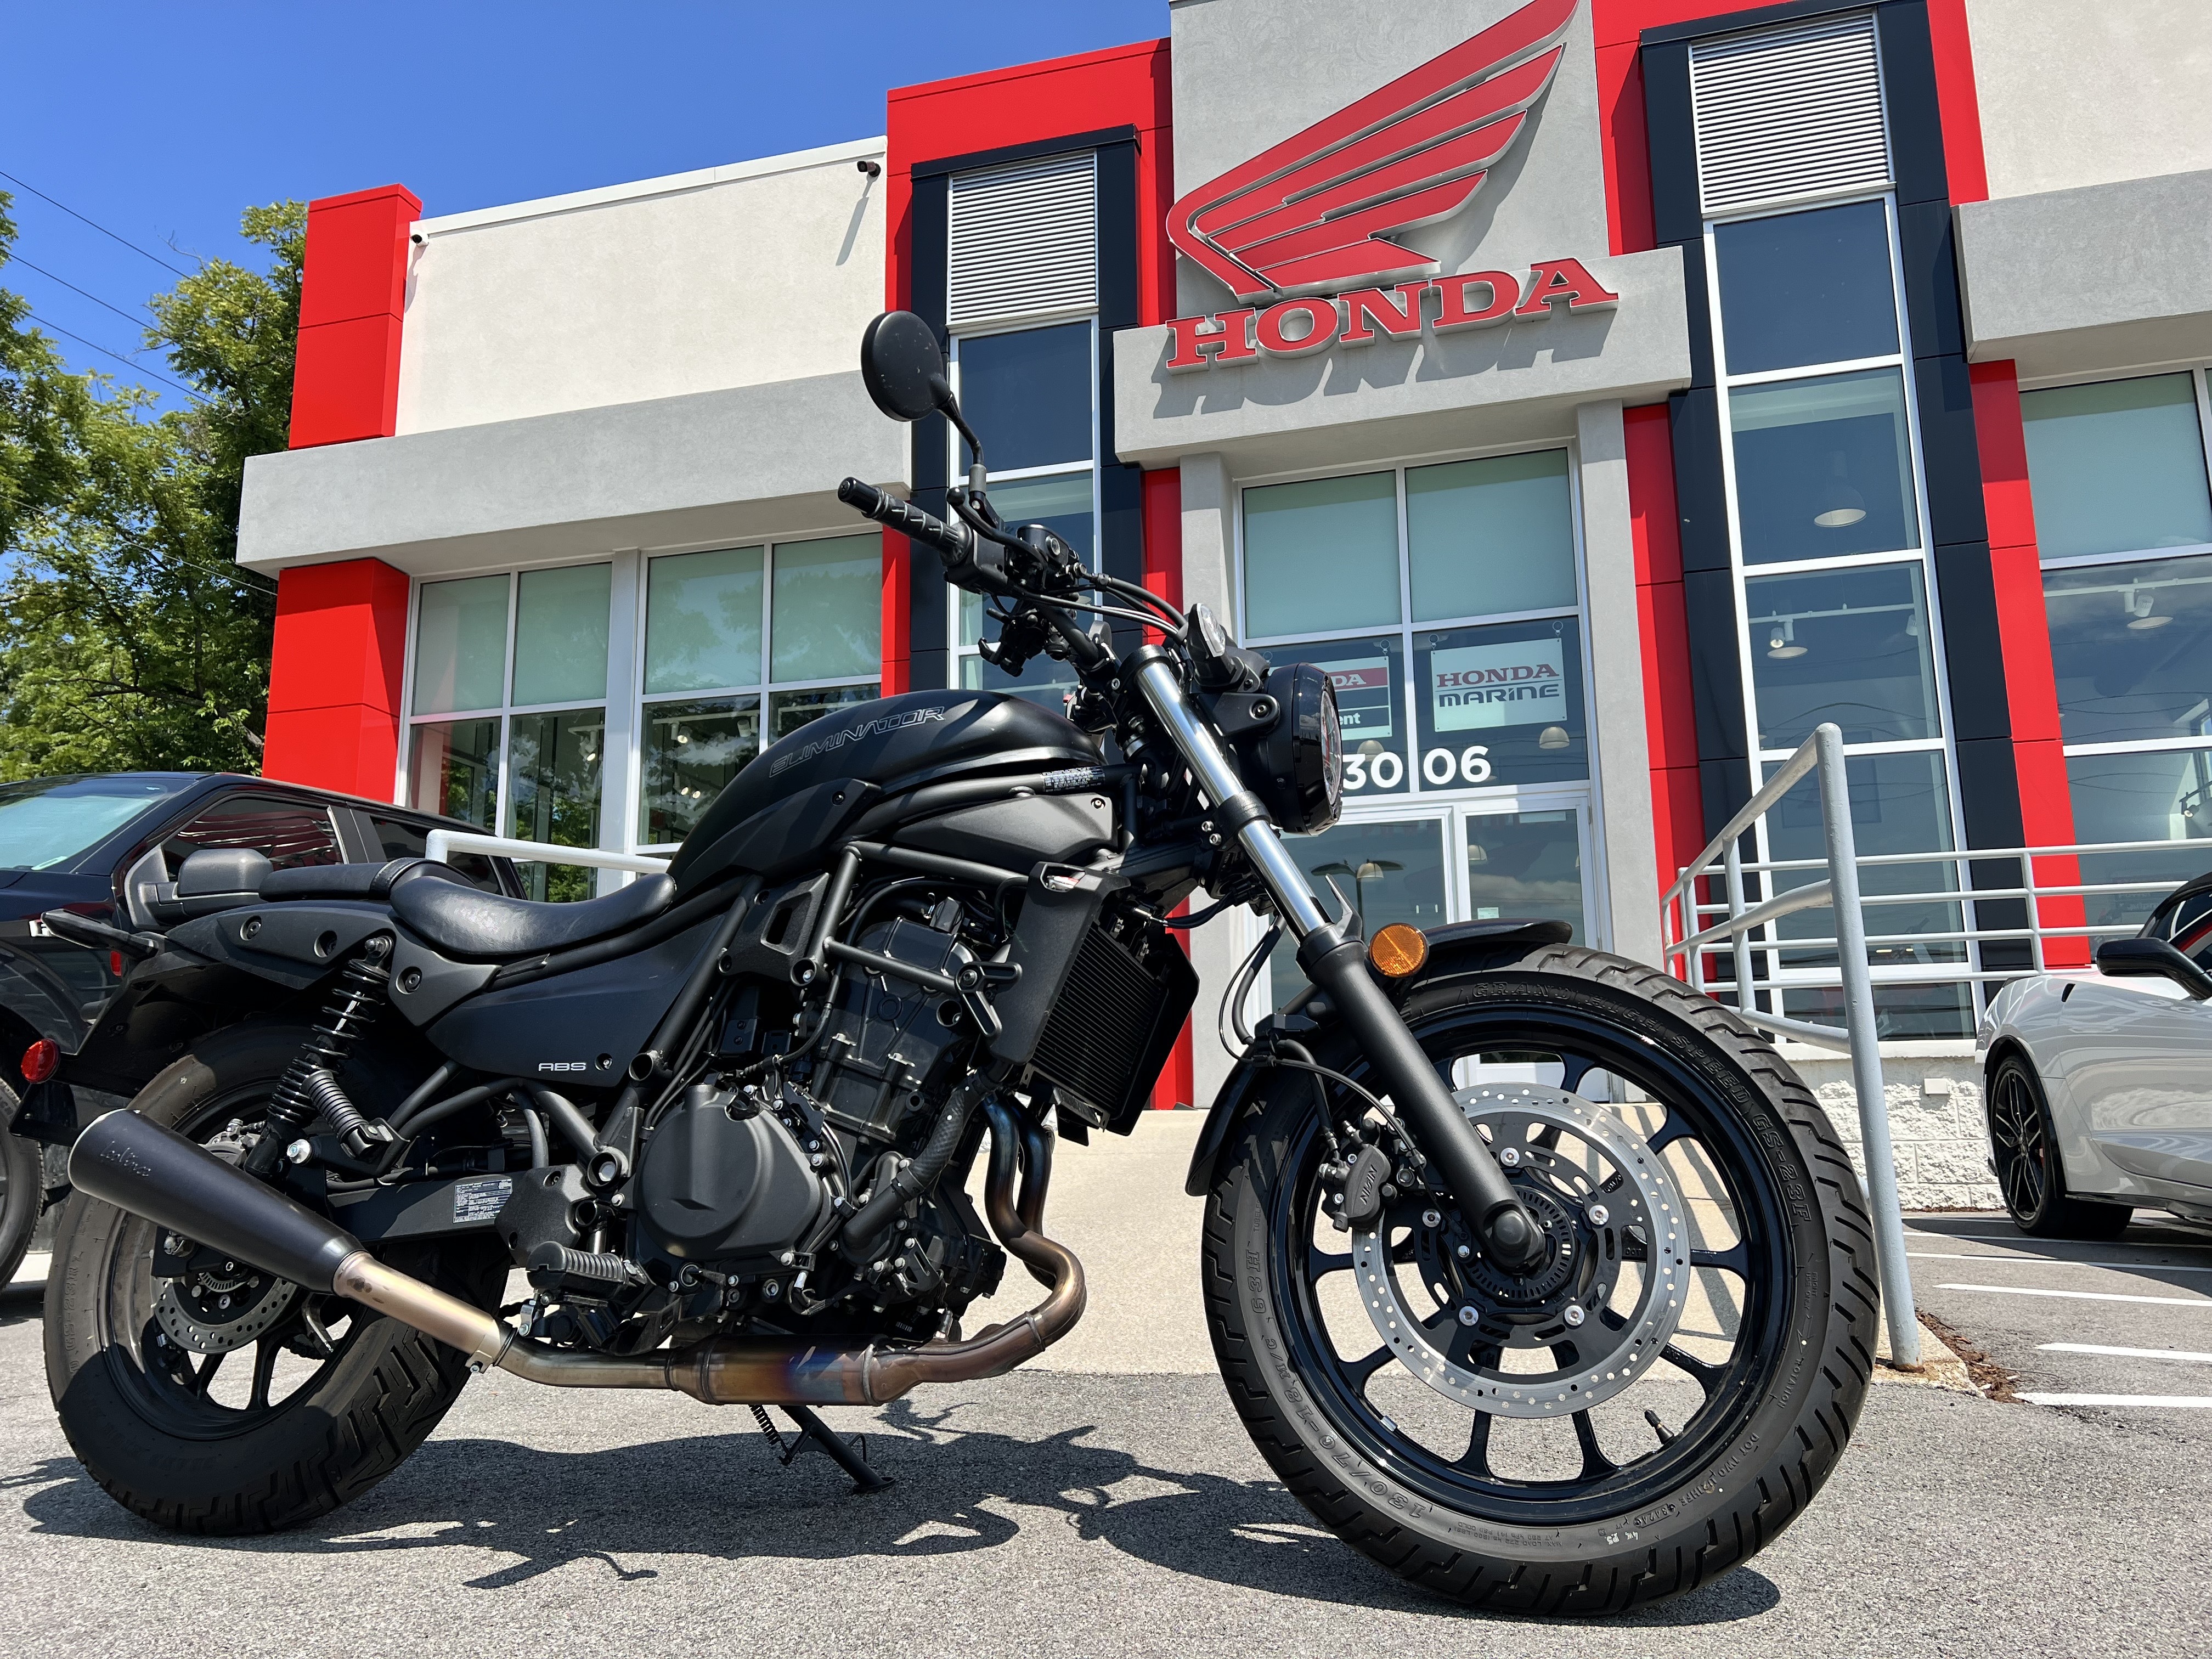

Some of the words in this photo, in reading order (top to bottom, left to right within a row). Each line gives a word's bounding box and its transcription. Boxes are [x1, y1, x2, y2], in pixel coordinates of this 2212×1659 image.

[1165, 257, 1618, 374] HONDA
[1436, 664, 1560, 687] HONDA
[769, 706, 945, 778] ELIMINATOR
[538, 1062, 587, 1071] ABS
[1739, 1432, 1760, 1457] DOT
